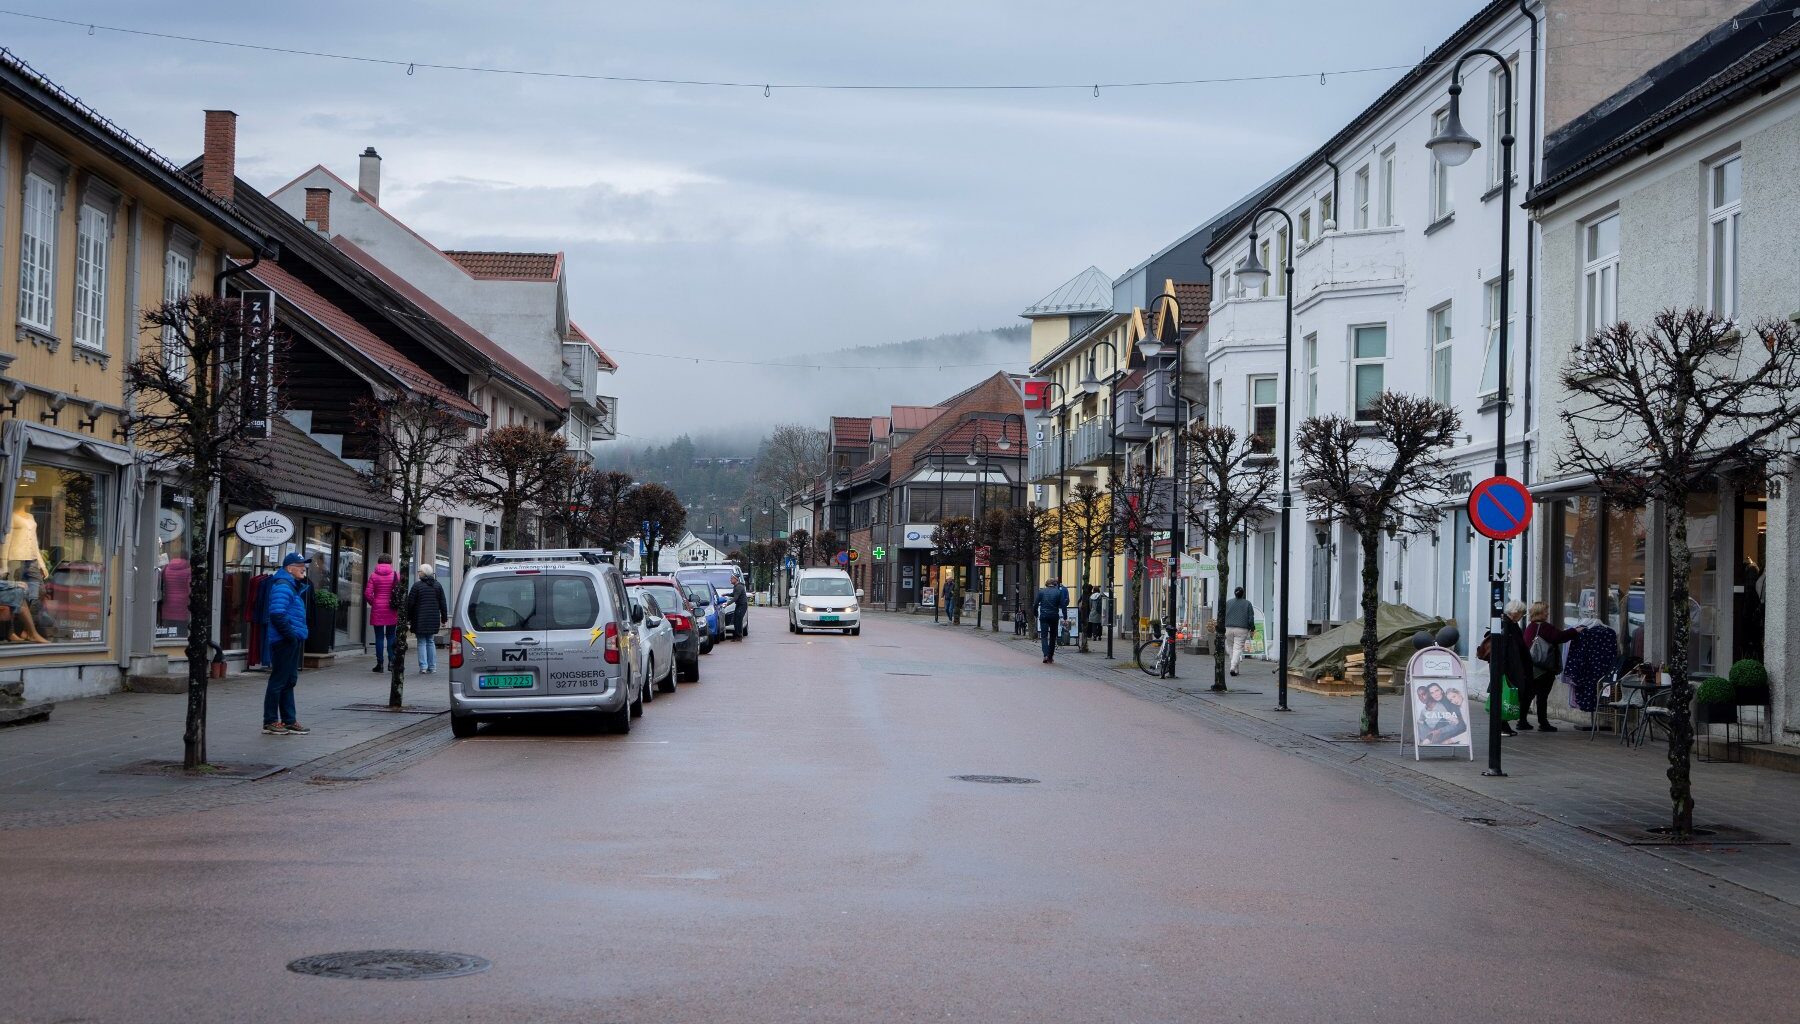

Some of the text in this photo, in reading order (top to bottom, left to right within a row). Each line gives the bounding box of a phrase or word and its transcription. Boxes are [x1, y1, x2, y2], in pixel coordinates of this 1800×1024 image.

[1769, 480, 1781, 499] 22
[550, 670, 605, 679] KONGSBERG
[487, 676, 530, 686] KU 12225
